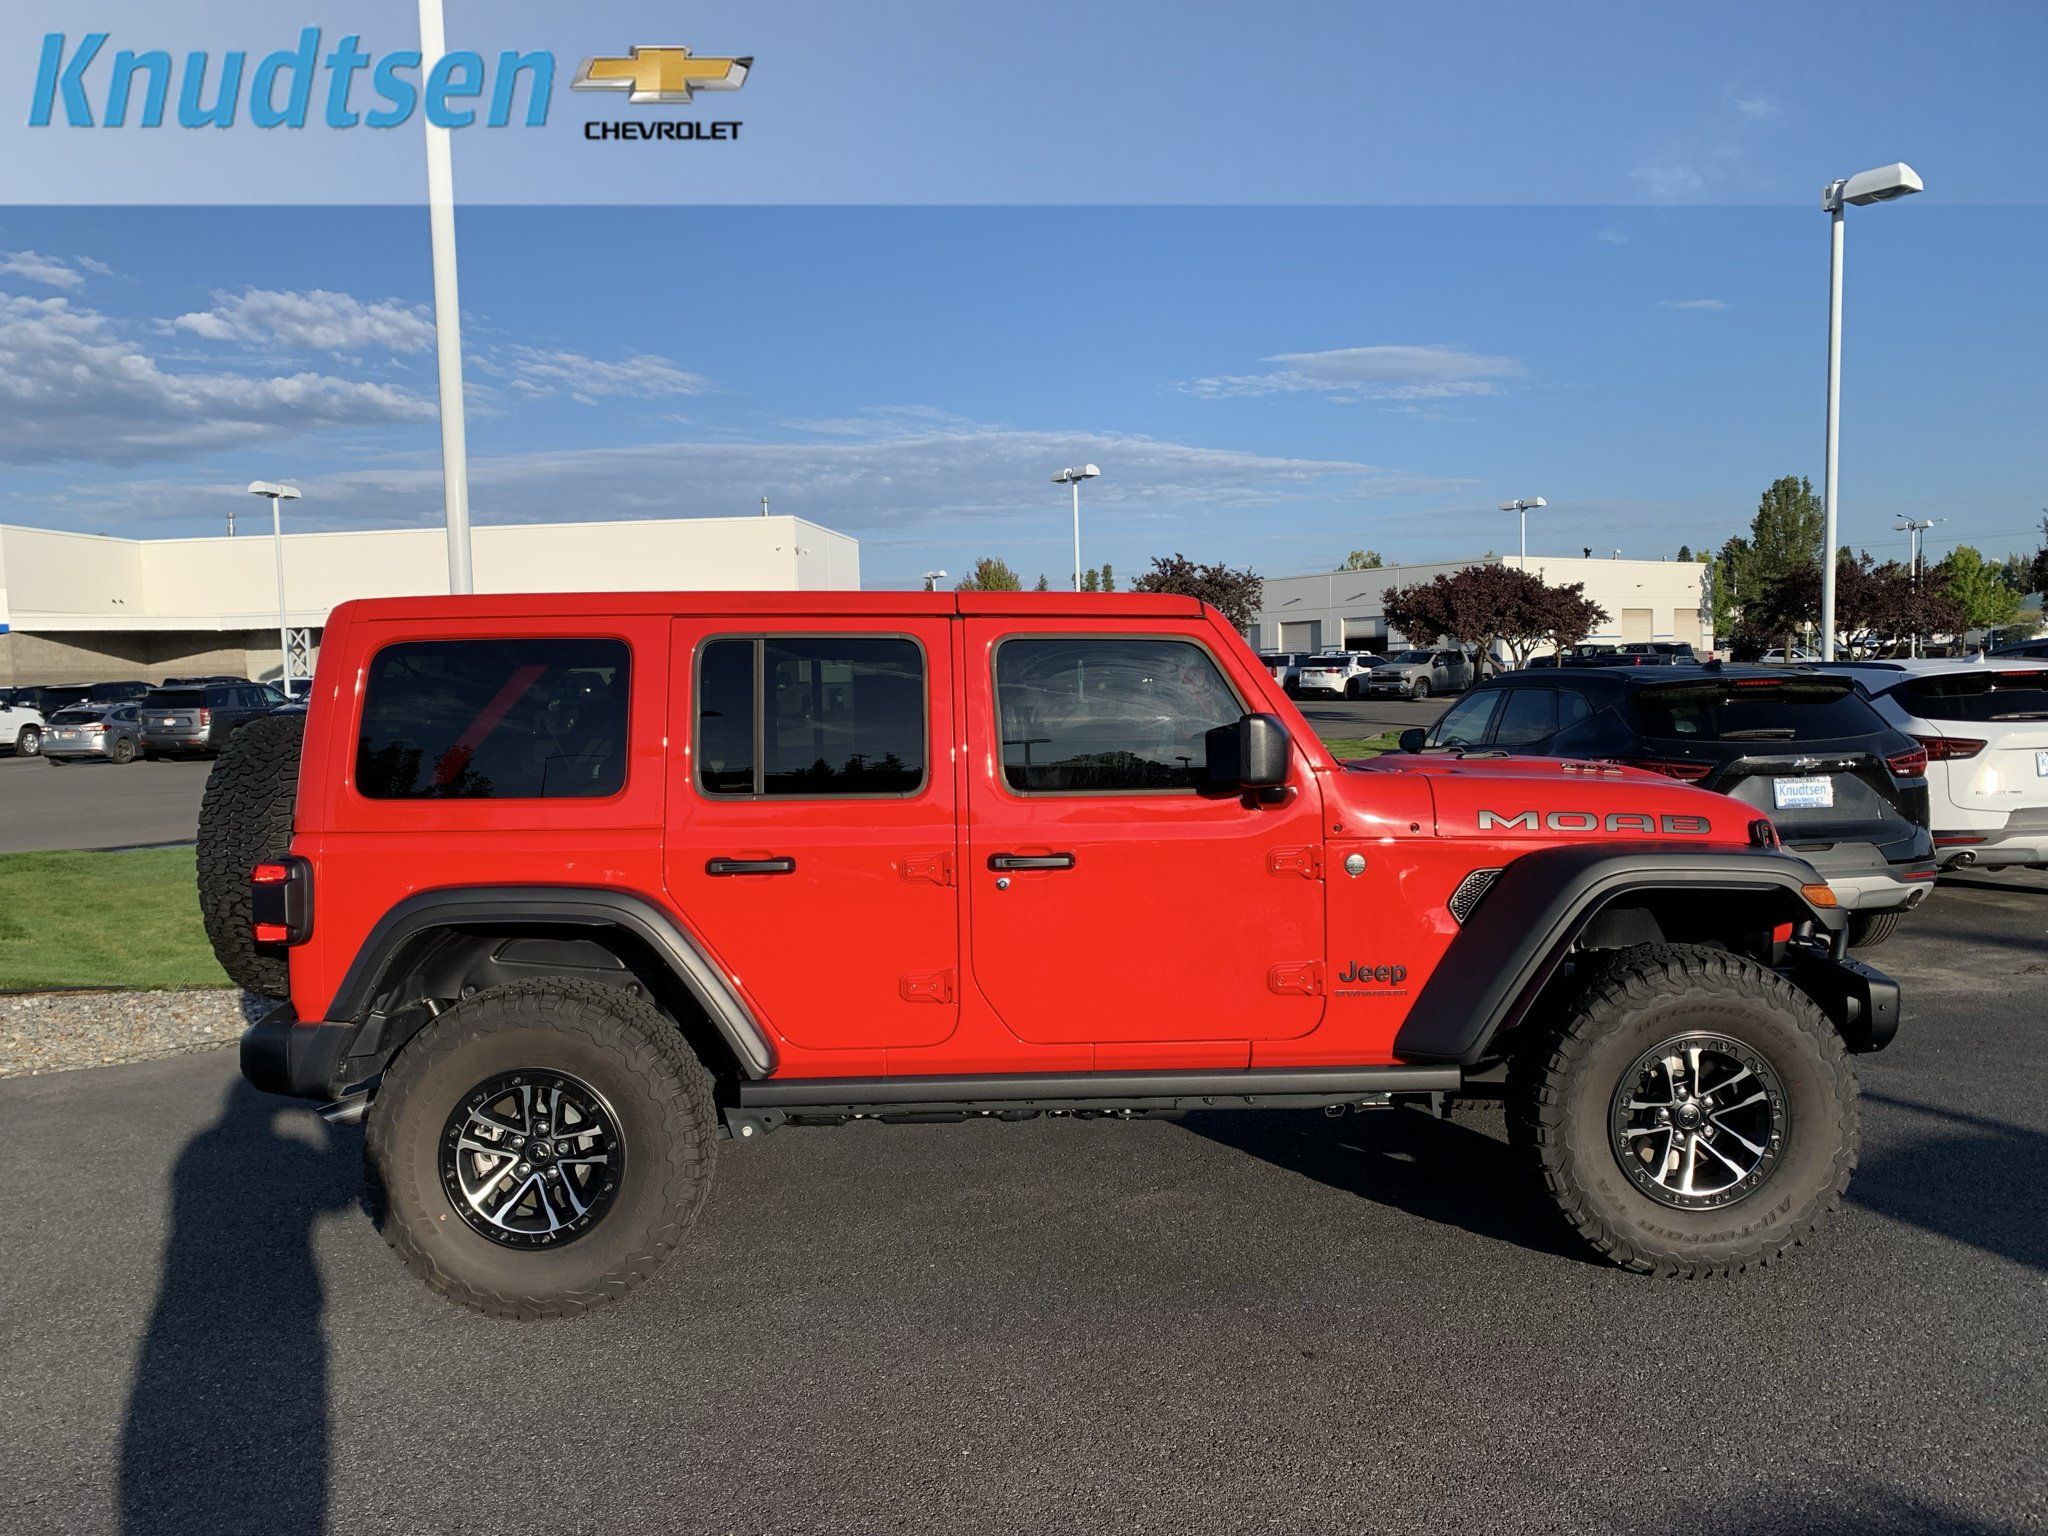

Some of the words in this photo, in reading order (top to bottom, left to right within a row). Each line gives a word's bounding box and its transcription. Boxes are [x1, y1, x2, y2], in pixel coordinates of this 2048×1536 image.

[1779, 783, 1826, 797] Knudtsen
[1478, 810, 1711, 834] MOAB
[1339, 960, 1407, 986] Jeep
